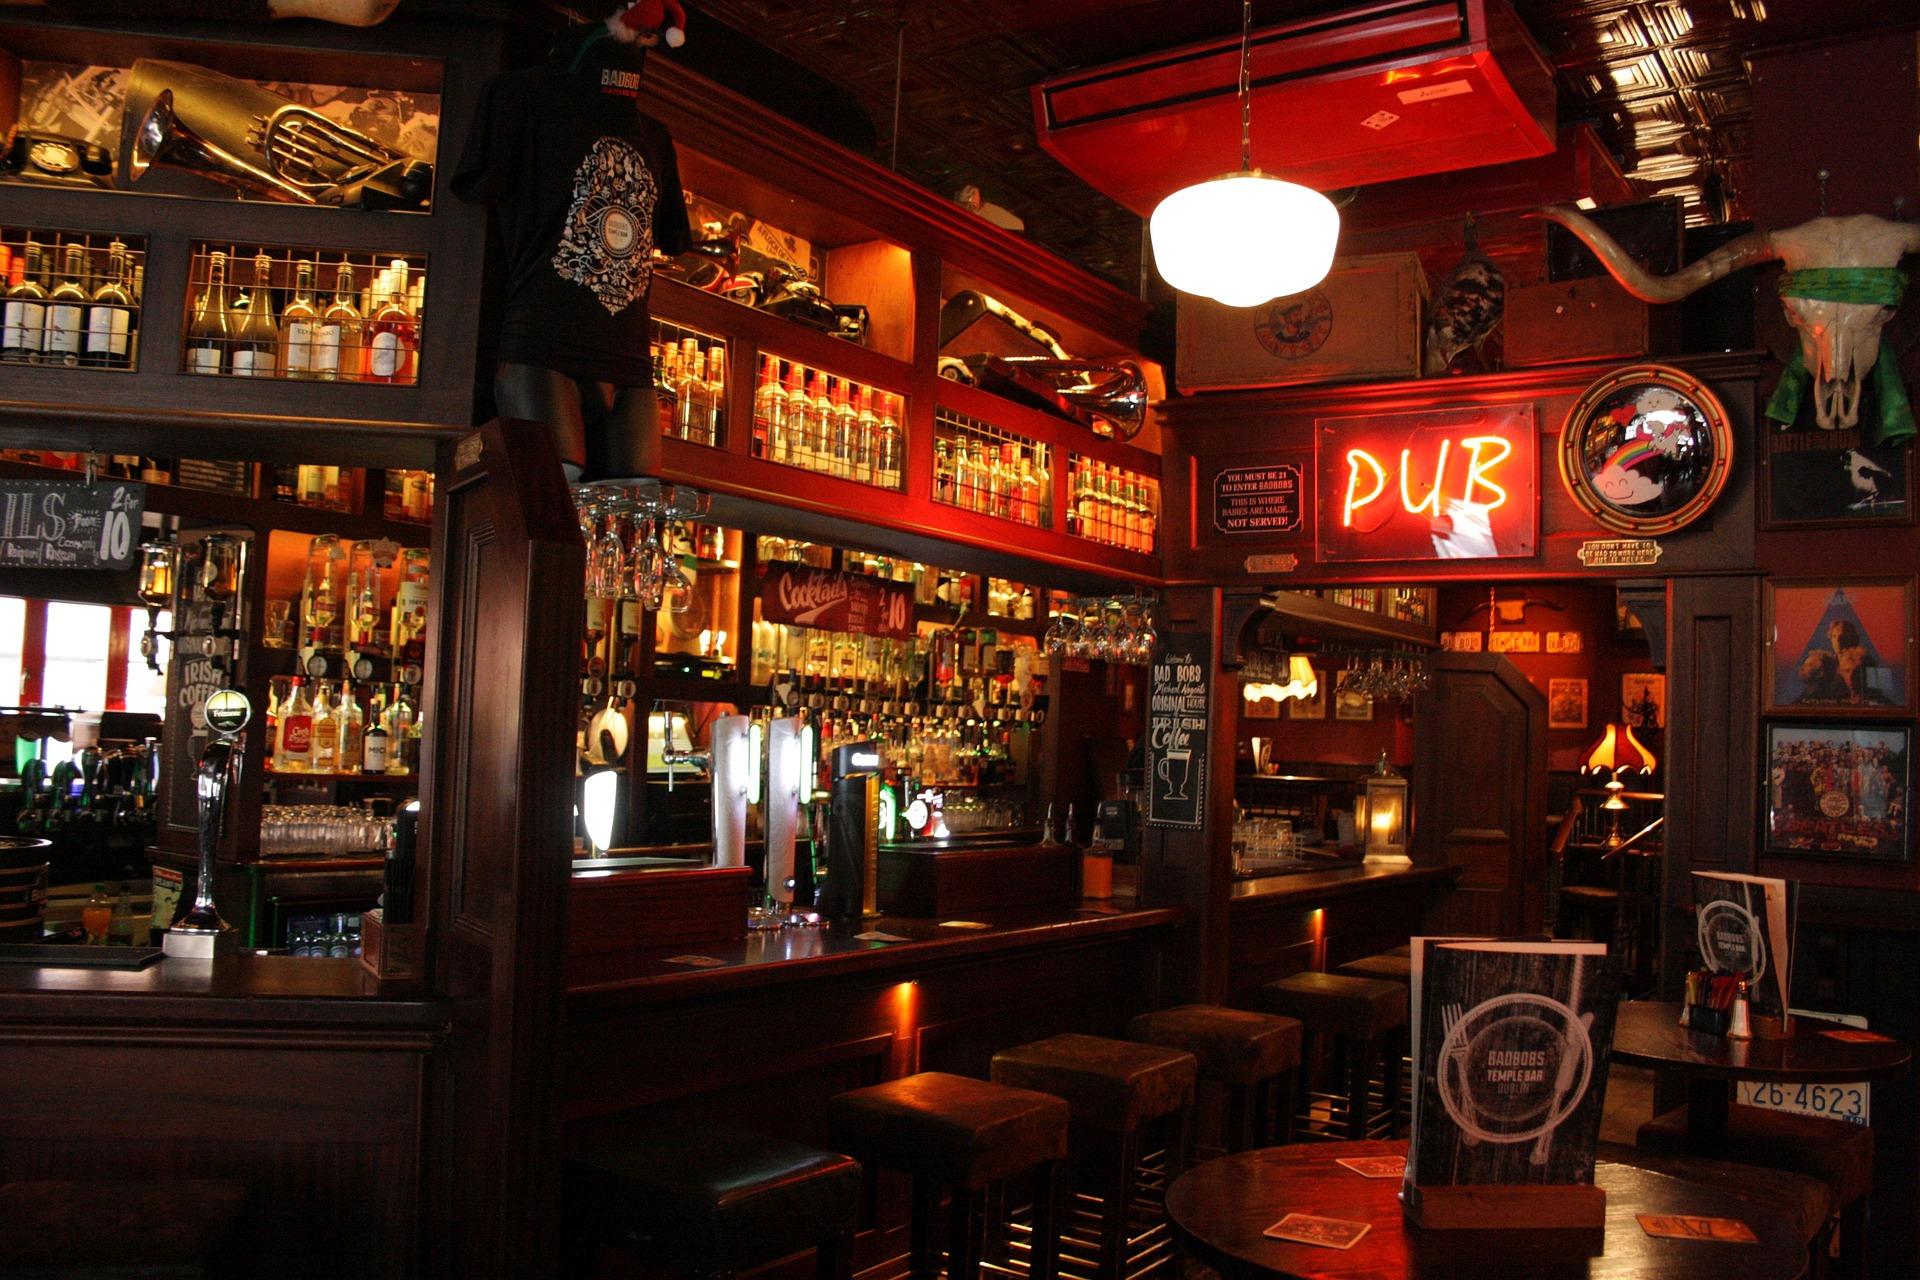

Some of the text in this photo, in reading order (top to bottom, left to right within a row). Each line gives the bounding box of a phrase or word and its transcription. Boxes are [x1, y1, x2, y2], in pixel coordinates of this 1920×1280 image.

[1228, 474, 1242, 482] YOU
[1244, 473, 1266, 481] MUST
[1279, 471, 1287, 479] 21
[1343, 435, 1512, 528] PUB
[1222, 480, 1293, 492] TO ENTER BADBOBS
[111, 486, 139, 512] 2 for
[1231, 498, 1248, 507] THIS
[1258, 496, 1285, 505] WHERE
[1222, 508, 1248, 516] BABIES
[1249, 506, 1264, 515] ARE
[1227, 517, 1288, 527] NOT SERVED!
[100, 510, 131, 561] 10
[778, 570, 848, 612] Cocktails
[889, 592, 906, 630] 10
[185, 660, 223, 686] IRISH
[1154, 664, 1201, 682] BAD BOBS
[1152, 695, 1186, 712] ORIGINAL
[1151, 724, 1190, 750] Coffee
[1487, 1050, 1546, 1067] BADBOBS
[1487, 1069, 1544, 1082] TEMPLE BAR
